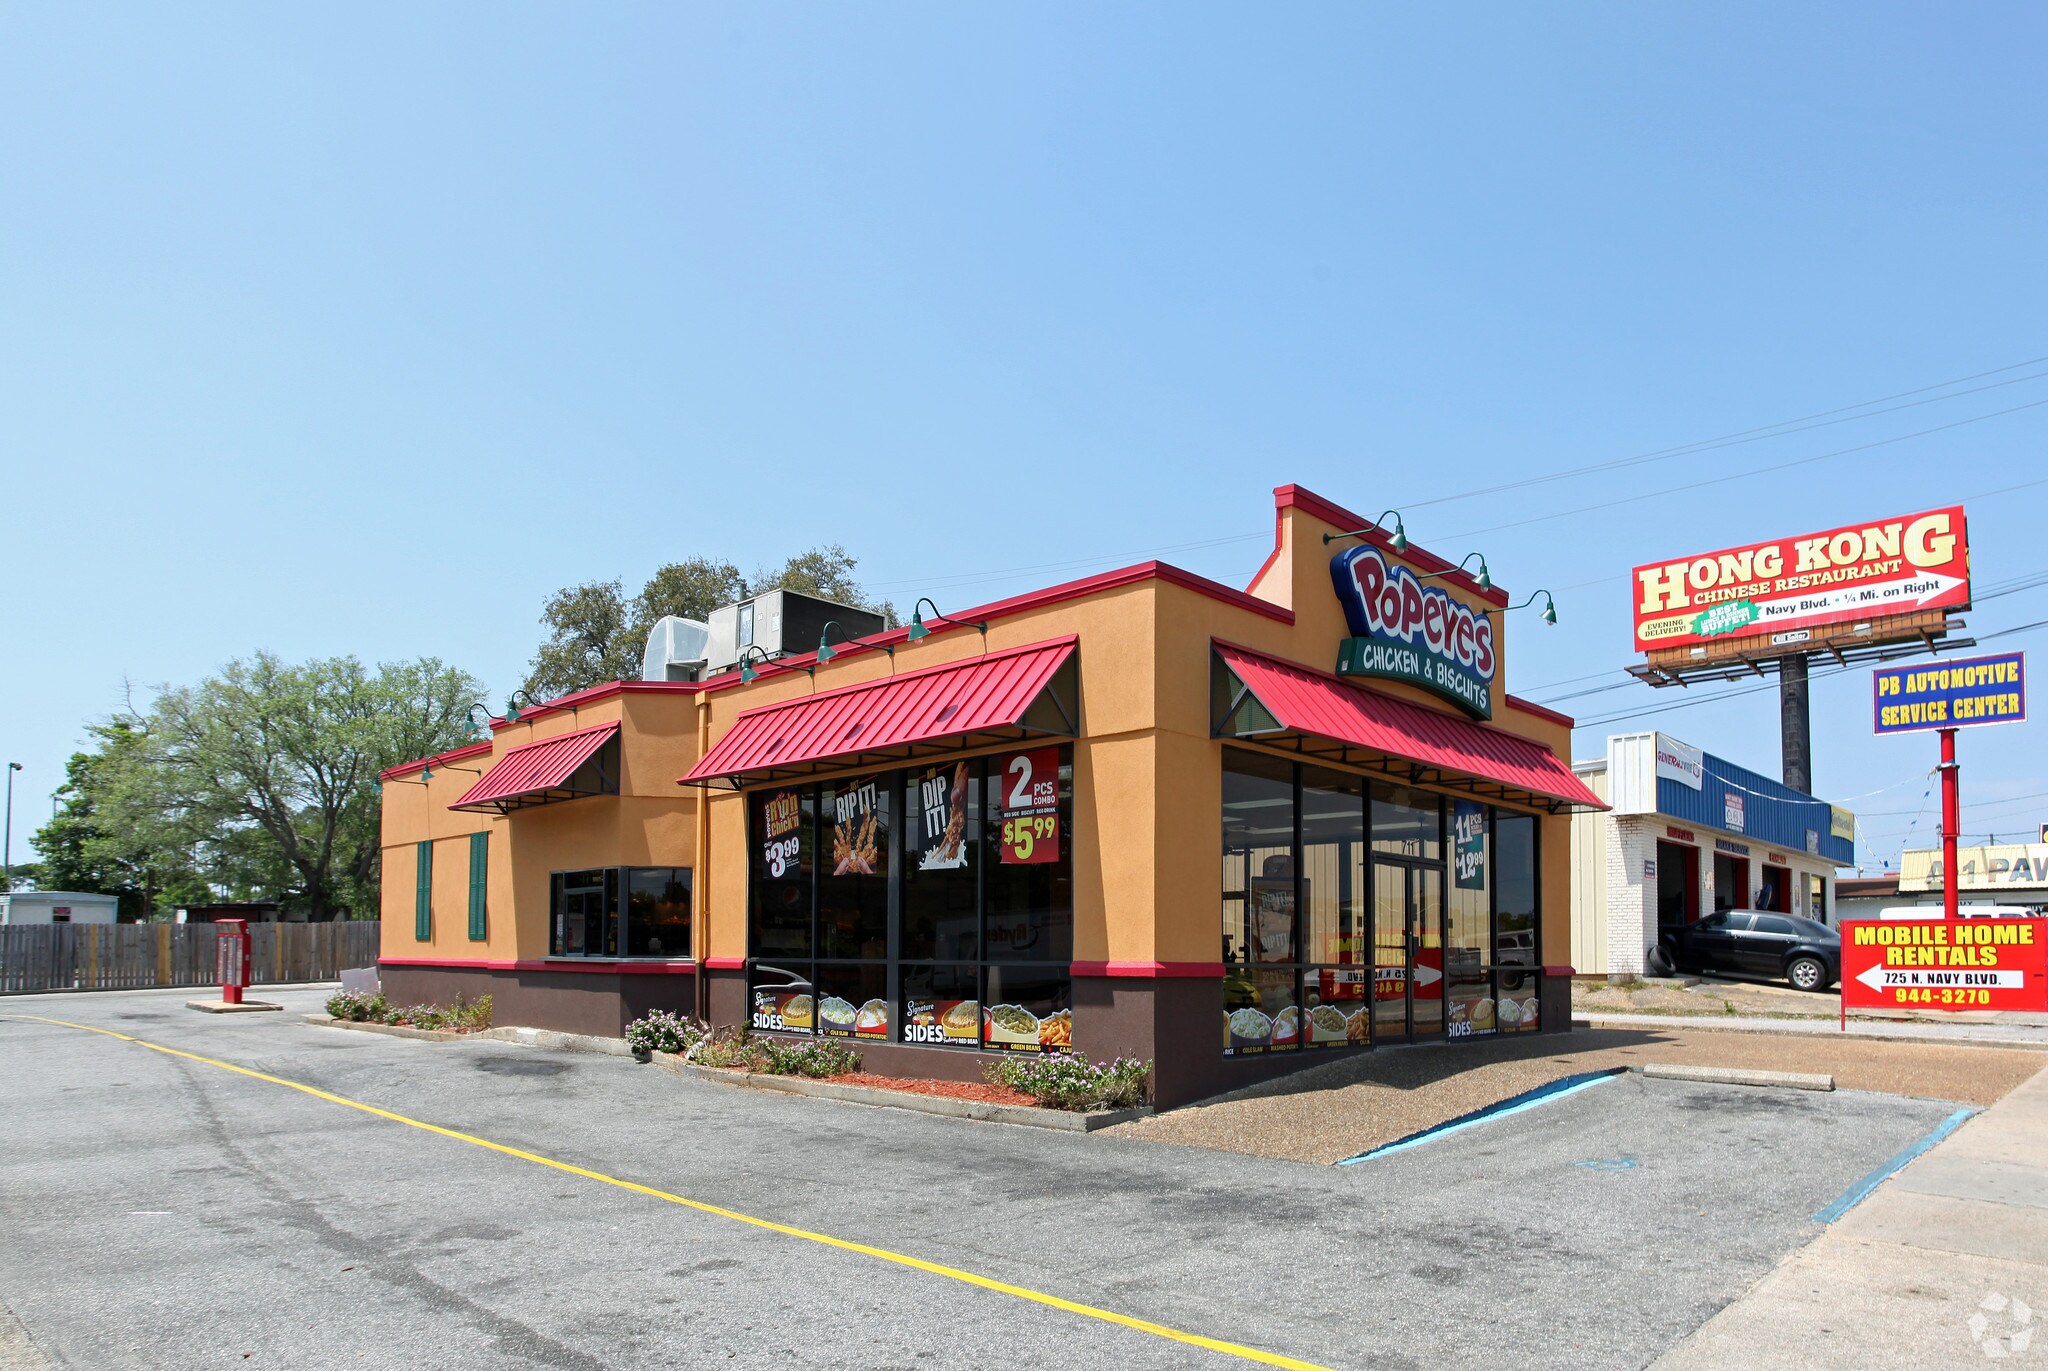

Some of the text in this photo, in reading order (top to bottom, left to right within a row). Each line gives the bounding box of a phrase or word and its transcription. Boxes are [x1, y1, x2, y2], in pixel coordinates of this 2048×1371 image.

[1639, 514, 1956, 614] HONG KONG
[1694, 559, 1902, 605] CHINESE RESTAURANT
[1766, 604, 1796, 616] Navy
[1800, 598, 1830, 610] Blvd.
[1860, 590, 1879, 601] Mi.
[1883, 588, 1900, 598] on
[1904, 580, 1940, 595] Right
[1709, 602, 1739, 619] BEST
[1645, 625, 1687, 638] DELIVERY!
[1647, 619, 1683, 631] EVENING
[1701, 612, 1751, 634] BUFFET!
[1363, 644, 1487, 709] CHICKEN & BISCUITS
[1879, 661, 2019, 696] PB AUTOMOTIVE
[1881, 693, 2020, 726] SERVICE CENTER
[1008, 755, 1053, 808] 2 PCS
[836, 783, 877, 824] RIP IT!
[922, 776, 947, 811] DIP
[1033, 795, 1056, 805] COMBO
[925, 805, 948, 838] IT!
[1455, 814, 1473, 844] 11
[1470, 813, 1482, 825] PCS
[1854, 925, 2034, 945] MOBILE HOME
[1887, 946, 1998, 966] RENTALS
[1884, 972, 2002, 985] 725 N. NAVY BLVD.
[1895, 988, 1990, 1005] 944-3270
[906, 1000, 934, 1017] Signature
[753, 1012, 783, 1030] SIDES
[1448, 1020, 1471, 1038] SIDES
[904, 1024, 944, 1043] SIDES
